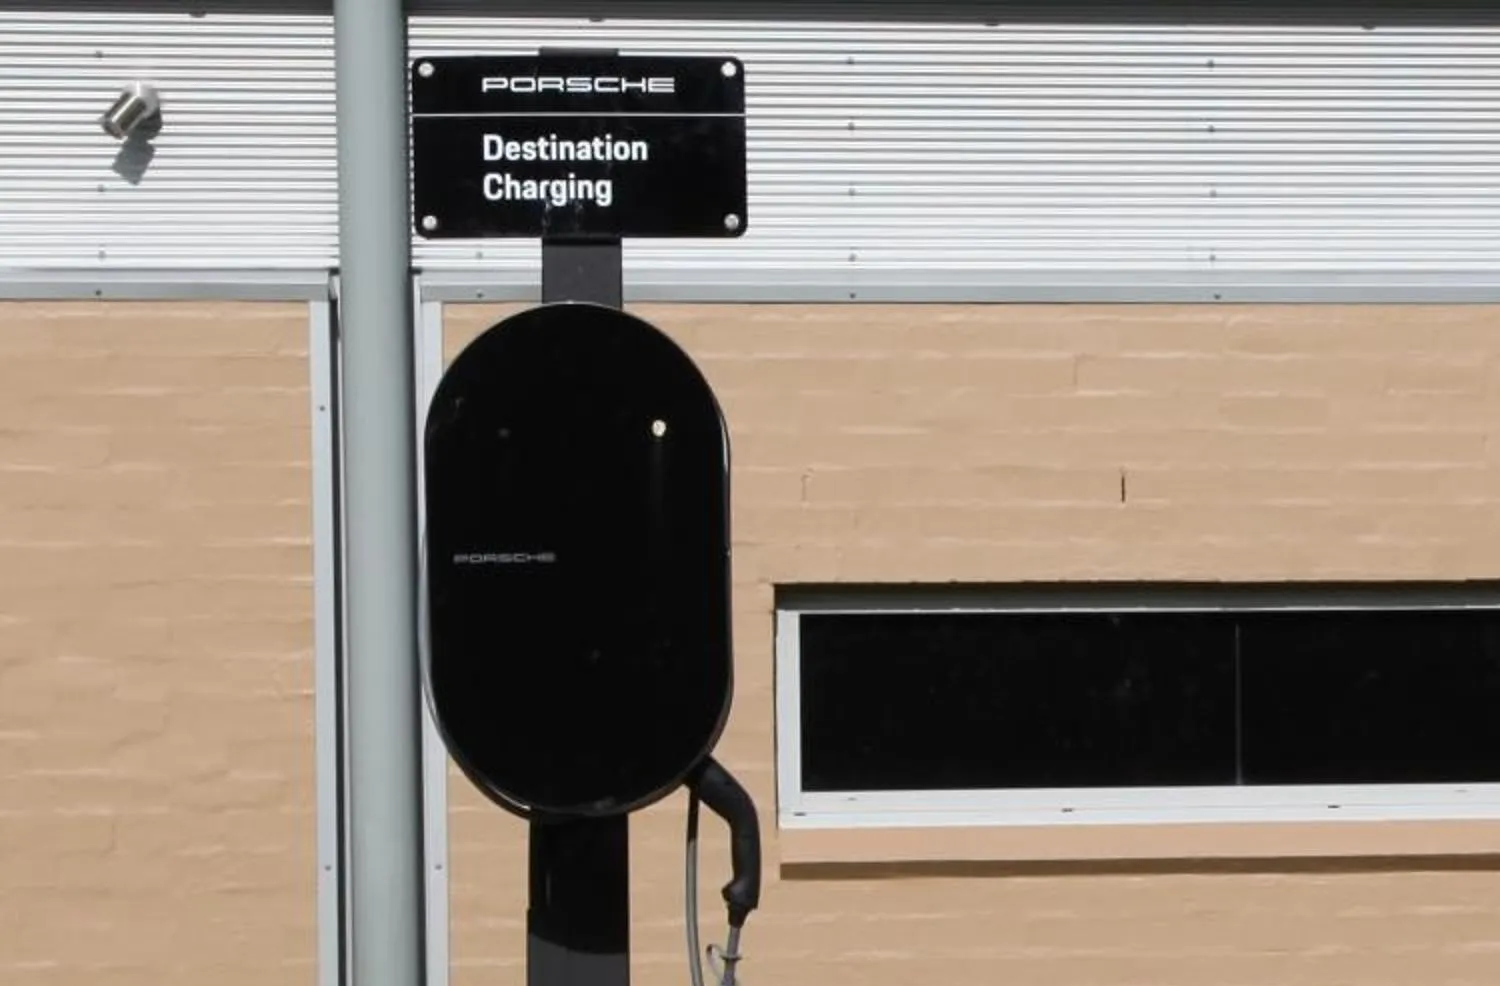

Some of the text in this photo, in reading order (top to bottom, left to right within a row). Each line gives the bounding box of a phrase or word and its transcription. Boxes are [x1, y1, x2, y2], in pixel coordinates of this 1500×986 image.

[482, 77, 675, 93] PORSCHE
[483, 134, 648, 161] Destination
[483, 173, 613, 206] Charging
[453, 552, 556, 564] PORSCHE
